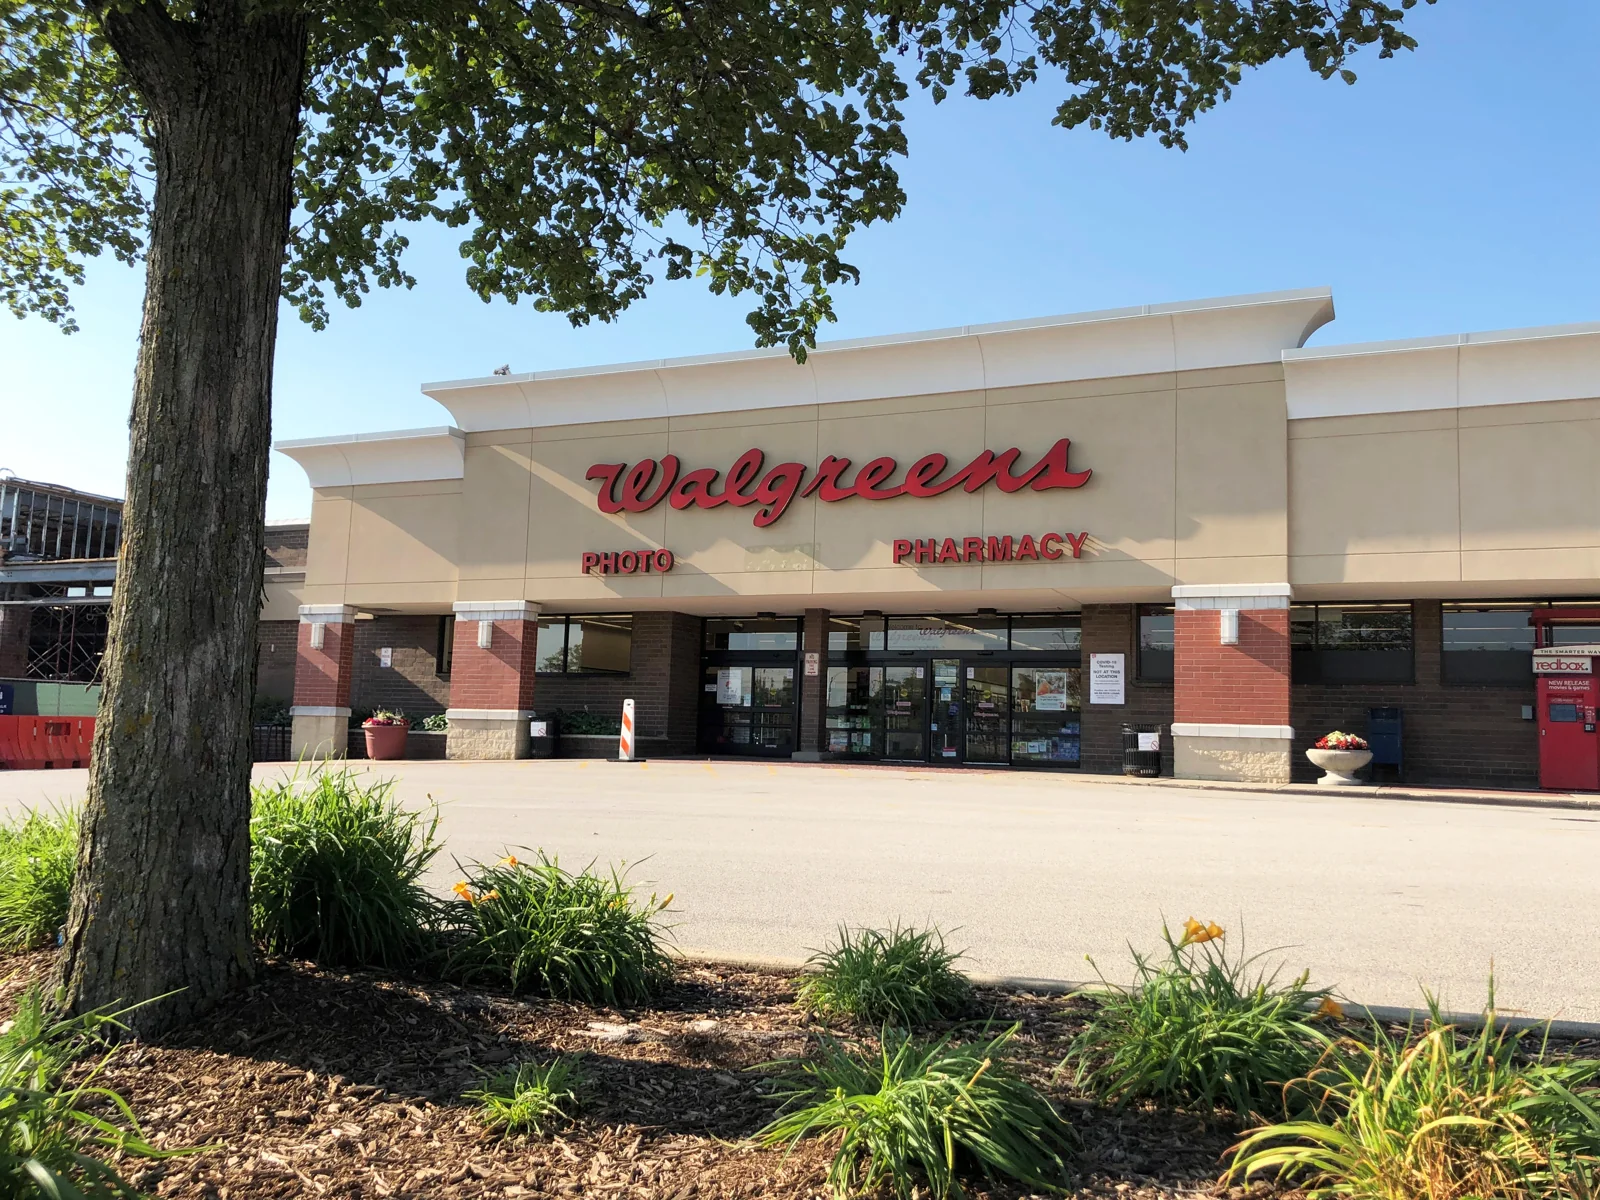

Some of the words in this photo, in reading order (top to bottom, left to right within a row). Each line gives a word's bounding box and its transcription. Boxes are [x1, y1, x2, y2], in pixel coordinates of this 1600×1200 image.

[585, 438, 1093, 527] Walgreens
[581, 548, 675, 575] PHOTO
[892, 532, 1089, 564] PHARMACY
[919, 627, 977, 637] Walgreens
